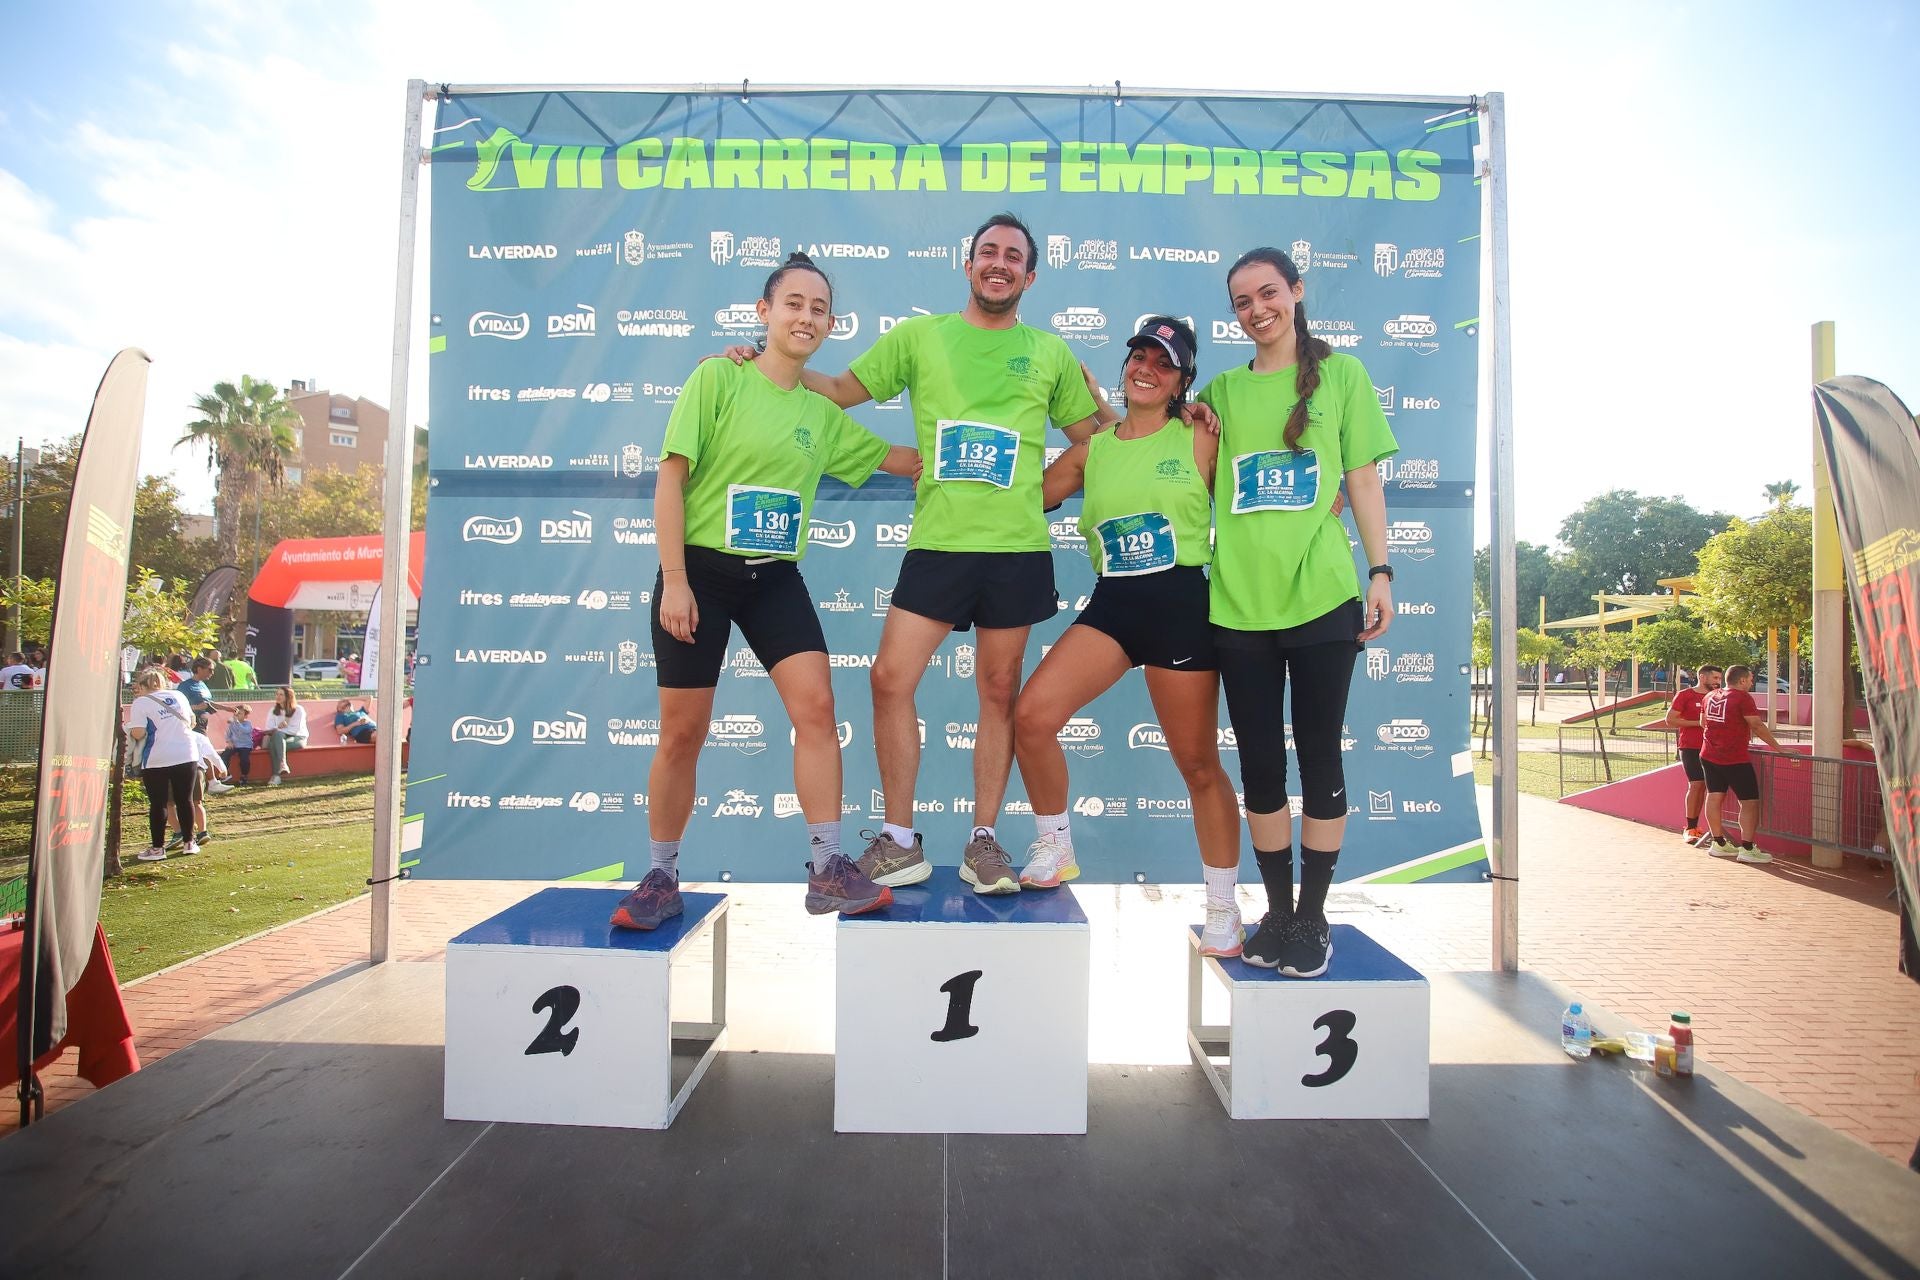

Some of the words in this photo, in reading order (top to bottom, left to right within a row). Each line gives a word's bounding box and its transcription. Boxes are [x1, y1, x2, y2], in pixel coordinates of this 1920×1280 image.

[511, 142, 604, 190] VII
[617, 137, 948, 192] CARRERA
[961, 141, 1048, 193] DE
[1060, 140, 1442, 202] EMPRESAS
[468, 245, 493, 259] LA
[493, 244, 558, 260] VERDAD
[575, 247, 612, 257] MURCIA
[647, 241, 694, 252] Ayuntamiento
[736, 248, 781, 258] ATLETISMO
[797, 244, 820, 258] LA
[820, 244, 889, 259] VERDAD
[647, 250, 656, 259] de
[657, 250, 682, 259] Murcia
[907, 250, 948, 258] MURCIA
[1073, 251, 1118, 260] ATLETISMO
[1129, 246, 1152, 260] LA
[1152, 247, 1220, 264] VERDAD
[1313, 251, 1358, 262] Ayuntamiento
[1312, 260, 1322, 268] de
[1322, 260, 1348, 269] Murcia
[1400, 260, 1445, 269] ATLETISMO
[478, 319, 522, 332] VIDAL
[547, 313, 596, 332] DSM
[1212, 320, 1247, 339] DS
[1306, 320, 1324, 331] MC
[468, 384, 511, 401] itres
[517, 386, 577, 400] atalayas
[613, 386, 633, 394] AÑOS
[642, 383, 683, 396] Broc
[1402, 396, 1441, 410] Hero
[958, 441, 998, 463] 132
[465, 455, 488, 469] LA
[488, 455, 553, 469] VERDAD
[569, 458, 609, 466] MURCIA
[1255, 468, 1296, 487] 131
[1395, 471, 1439, 479] ATLETISMO
[753, 510, 790, 531] 130
[472, 523, 515, 536] VIDAL
[540, 519, 592, 538] DSM
[876, 524, 912, 542] DS
[1117, 531, 1155, 553] 129
[281, 549, 342, 565] Ayuntamiento
[343, 548, 356, 561] de
[357, 546, 384, 560] Murc
[460, 589, 503, 605] itres
[509, 592, 571, 606] atalayas
[610, 593, 630, 602] AÑOS
[819, 601, 865, 609] ESTRELLA
[1398, 602, 1436, 614] Hero
[455, 649, 479, 663] LA
[479, 649, 547, 664] VERDAD
[565, 654, 605, 662] MURCIA
[730, 659, 763, 668] ATLETIS
[828, 654, 877, 668] ERDA
[1391, 665, 1435, 673] ATLETISMO
[461, 723, 505, 737] VIDAL
[532, 720, 587, 739] DSM
[1137, 730, 1167, 743] VID
[447, 792, 491, 808] itres
[498, 794, 563, 808] atalayas
[602, 796, 623, 804] AÑOS
[953, 797, 976, 813] itr
[1106, 800, 1126, 808] AÑOS
[1136, 797, 1191, 810] Brocal
[1402, 799, 1442, 813] Hero
[929, 968, 983, 1043] 1
[523, 984, 583, 1058] 2
[1300, 1008, 1359, 1089] 3
